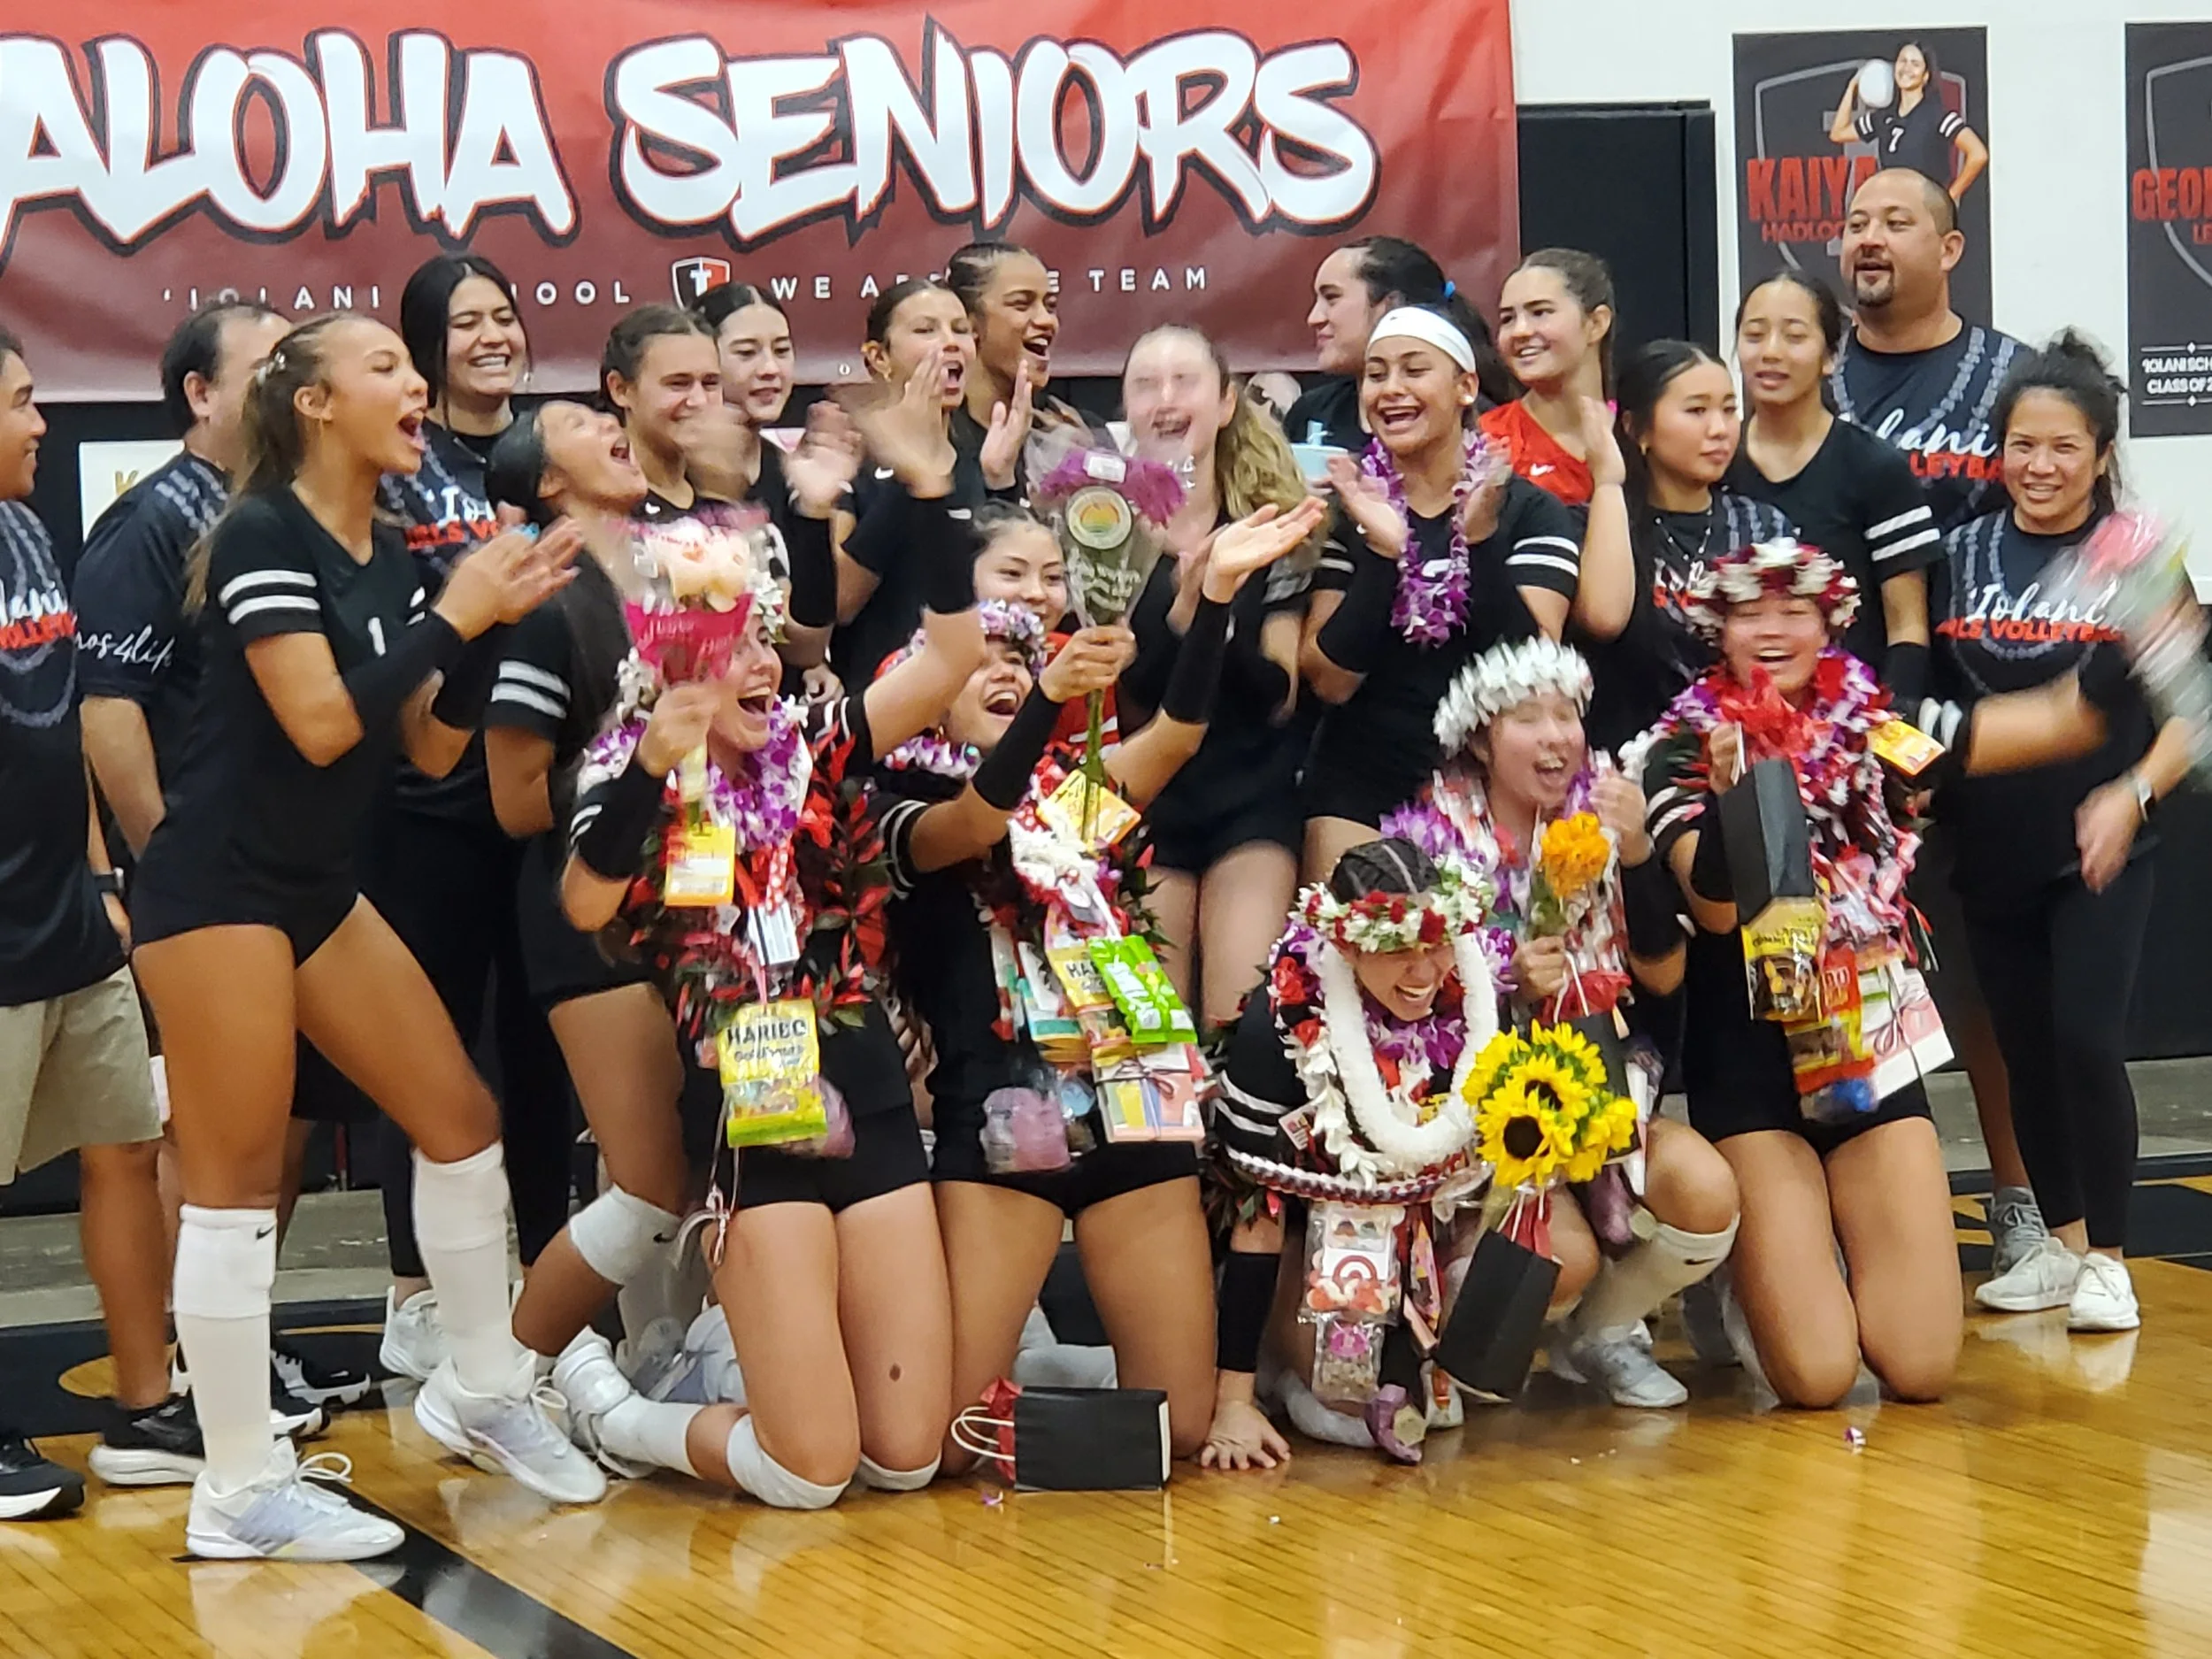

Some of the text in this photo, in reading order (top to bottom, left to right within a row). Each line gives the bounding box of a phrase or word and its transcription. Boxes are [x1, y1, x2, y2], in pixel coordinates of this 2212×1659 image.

[0, 19, 1378, 253] ALOHA SENIORS
[1888, 127, 1905, 153] 7
[770, 275, 832, 300] WE
[1089, 267, 1206, 292] TEAM
[2147, 377, 2188, 394] CLASS
